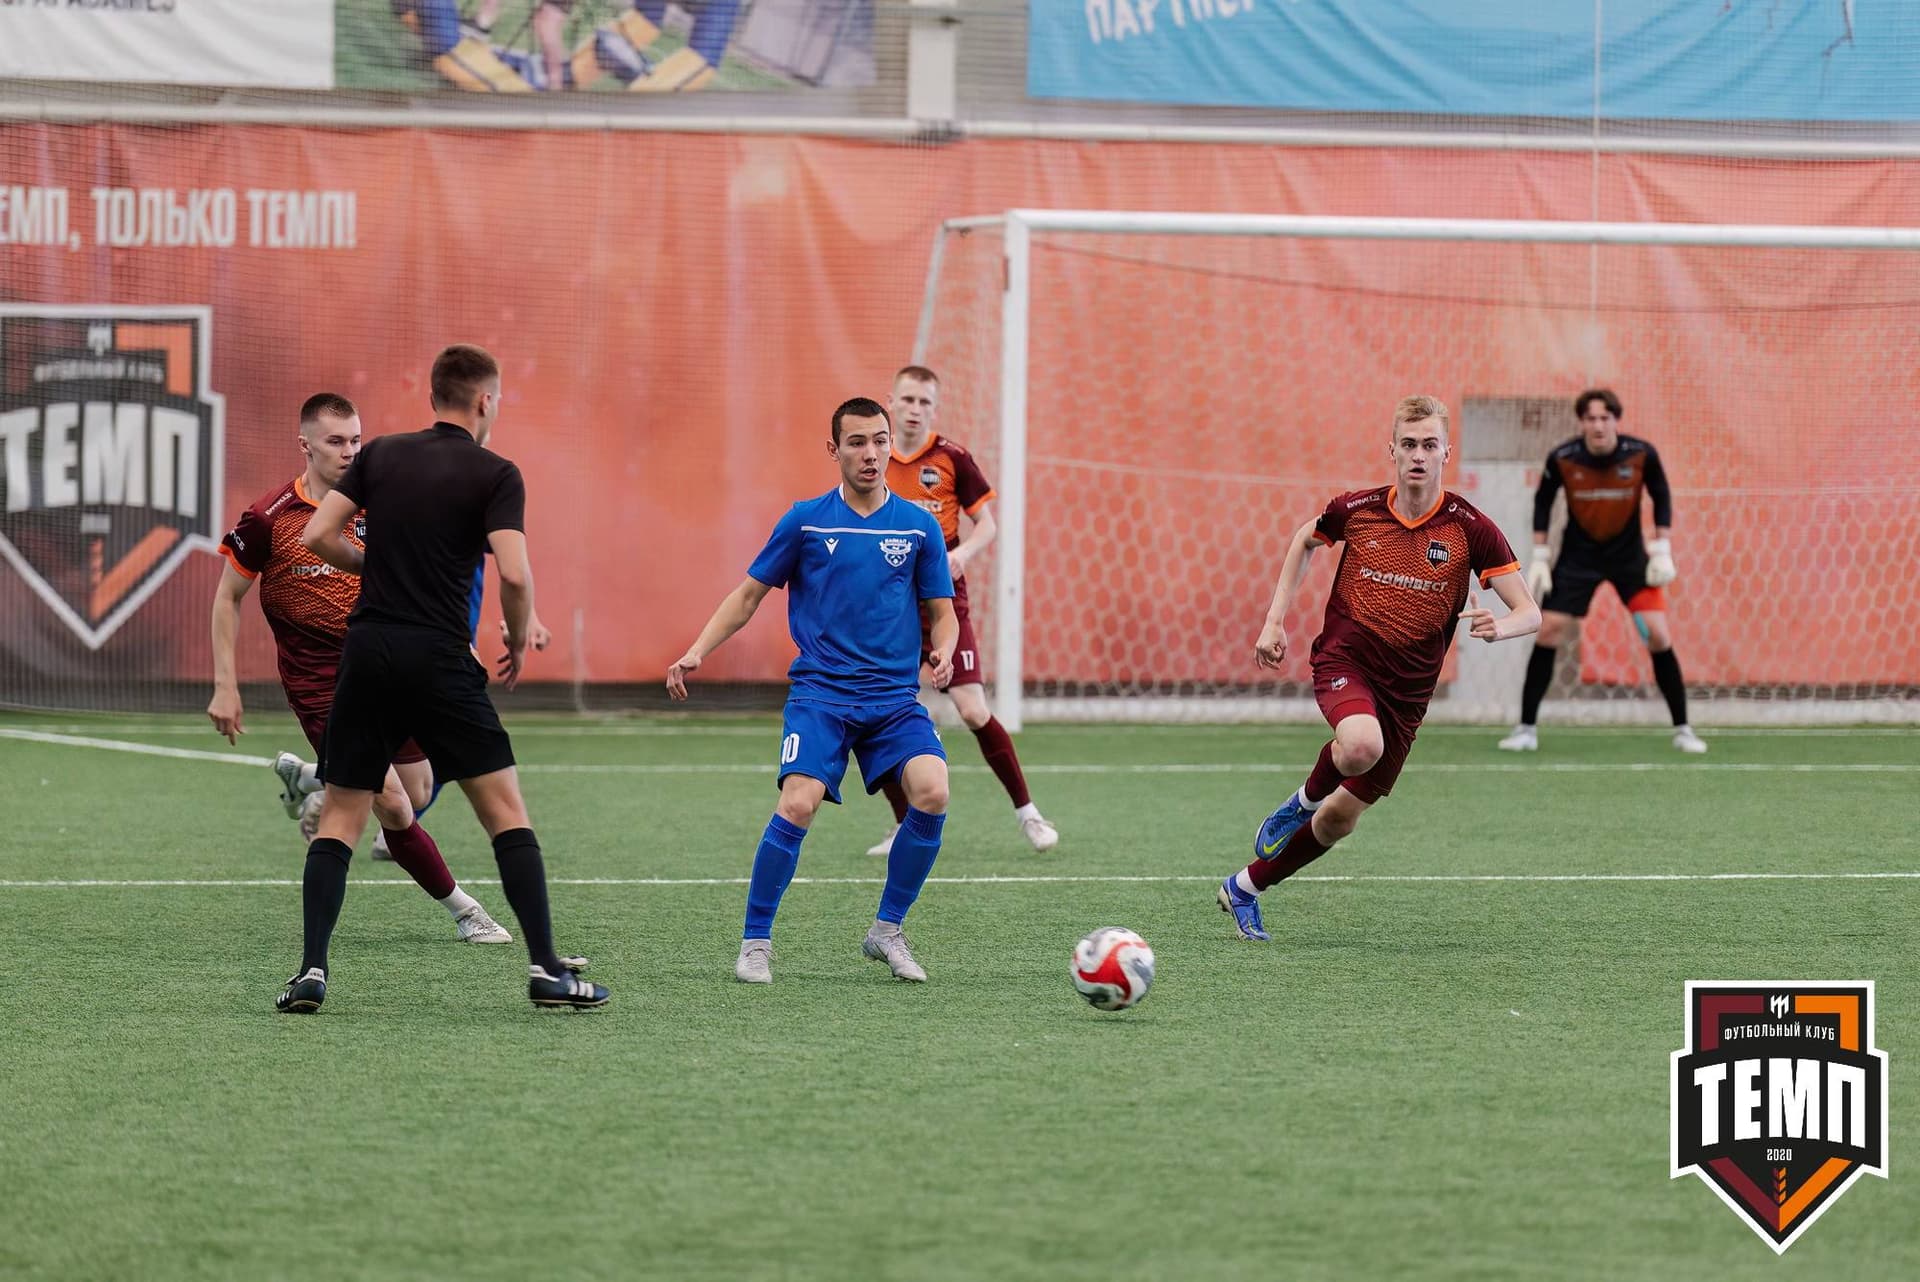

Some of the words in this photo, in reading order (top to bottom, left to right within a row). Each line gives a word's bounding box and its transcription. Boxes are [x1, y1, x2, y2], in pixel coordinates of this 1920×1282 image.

[91, 187, 236, 247] ТОЛЬКО
[247, 190, 357, 248] ТЕМП!
[0, 402, 200, 518] ТЕМП
[1429, 548, 1448, 562] ТЕМП
[781, 732, 800, 765] 10
